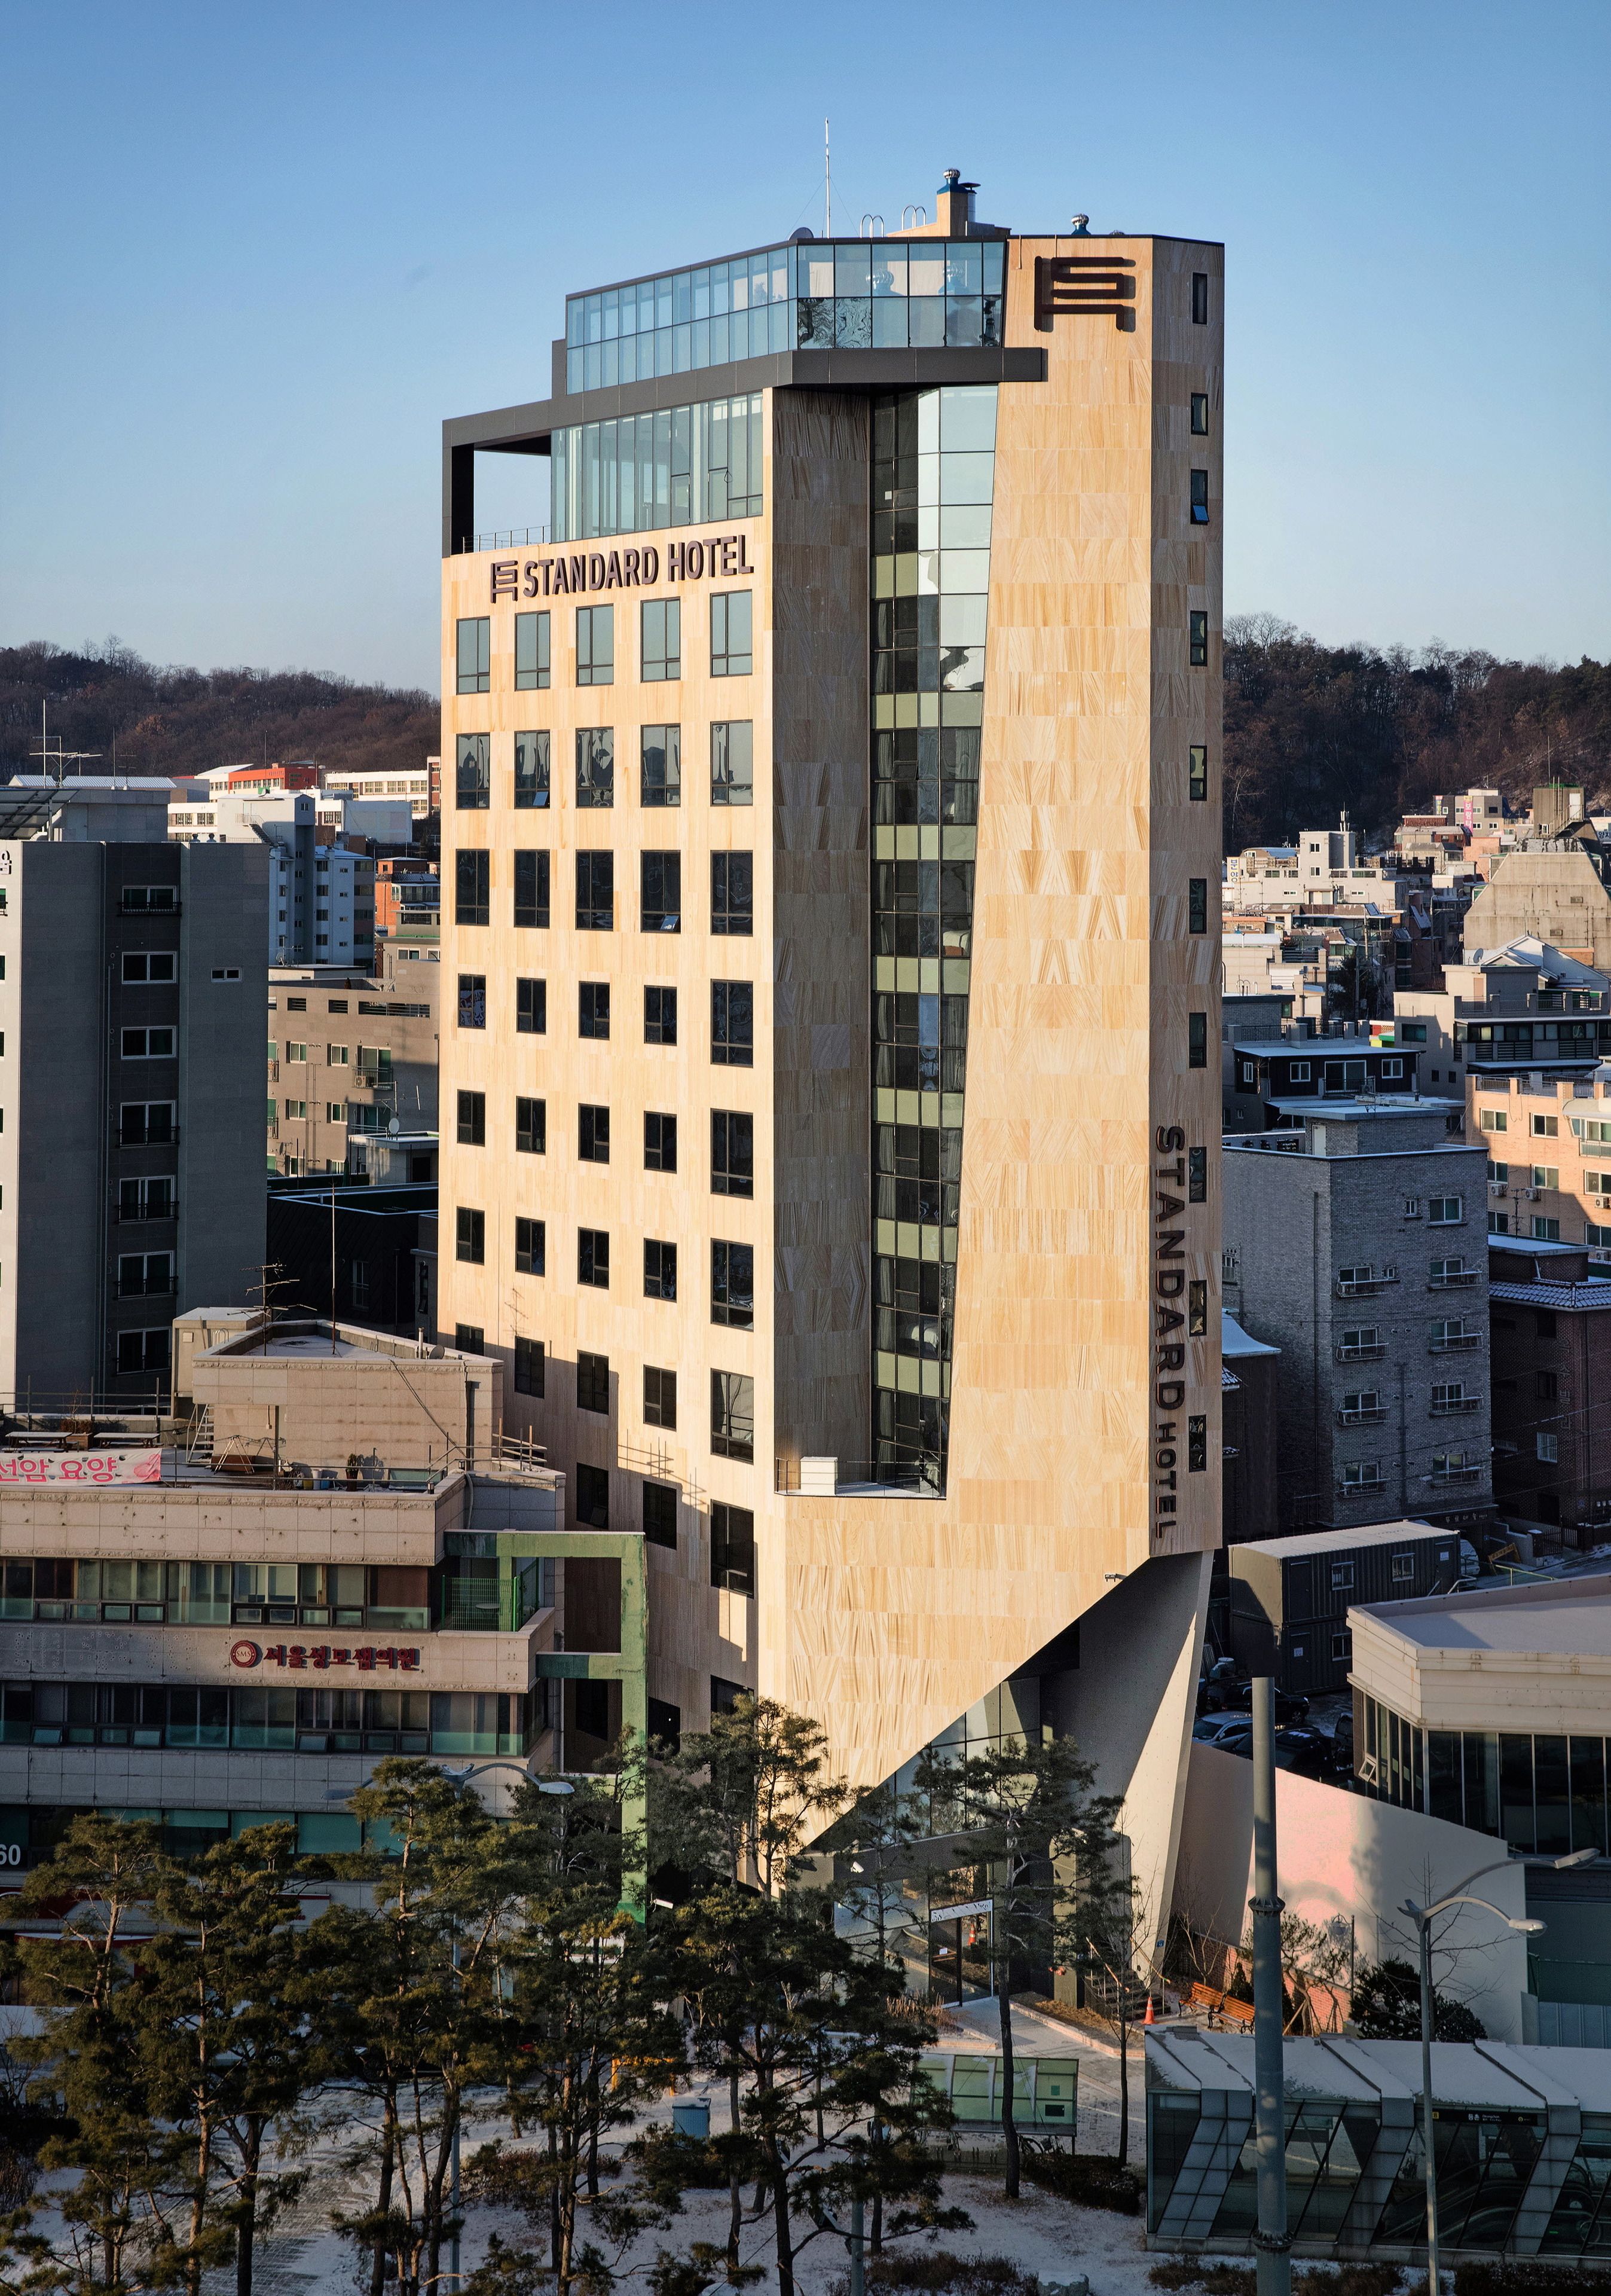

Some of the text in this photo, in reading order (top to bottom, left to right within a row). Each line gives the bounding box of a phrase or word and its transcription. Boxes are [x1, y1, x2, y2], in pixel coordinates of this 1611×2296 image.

[524, 535, 754, 597] STANDARD HOTEL
[1155, 1125, 1185, 1540] STANDARD HOTEL
[59, 1457, 118, 1483] 요양
